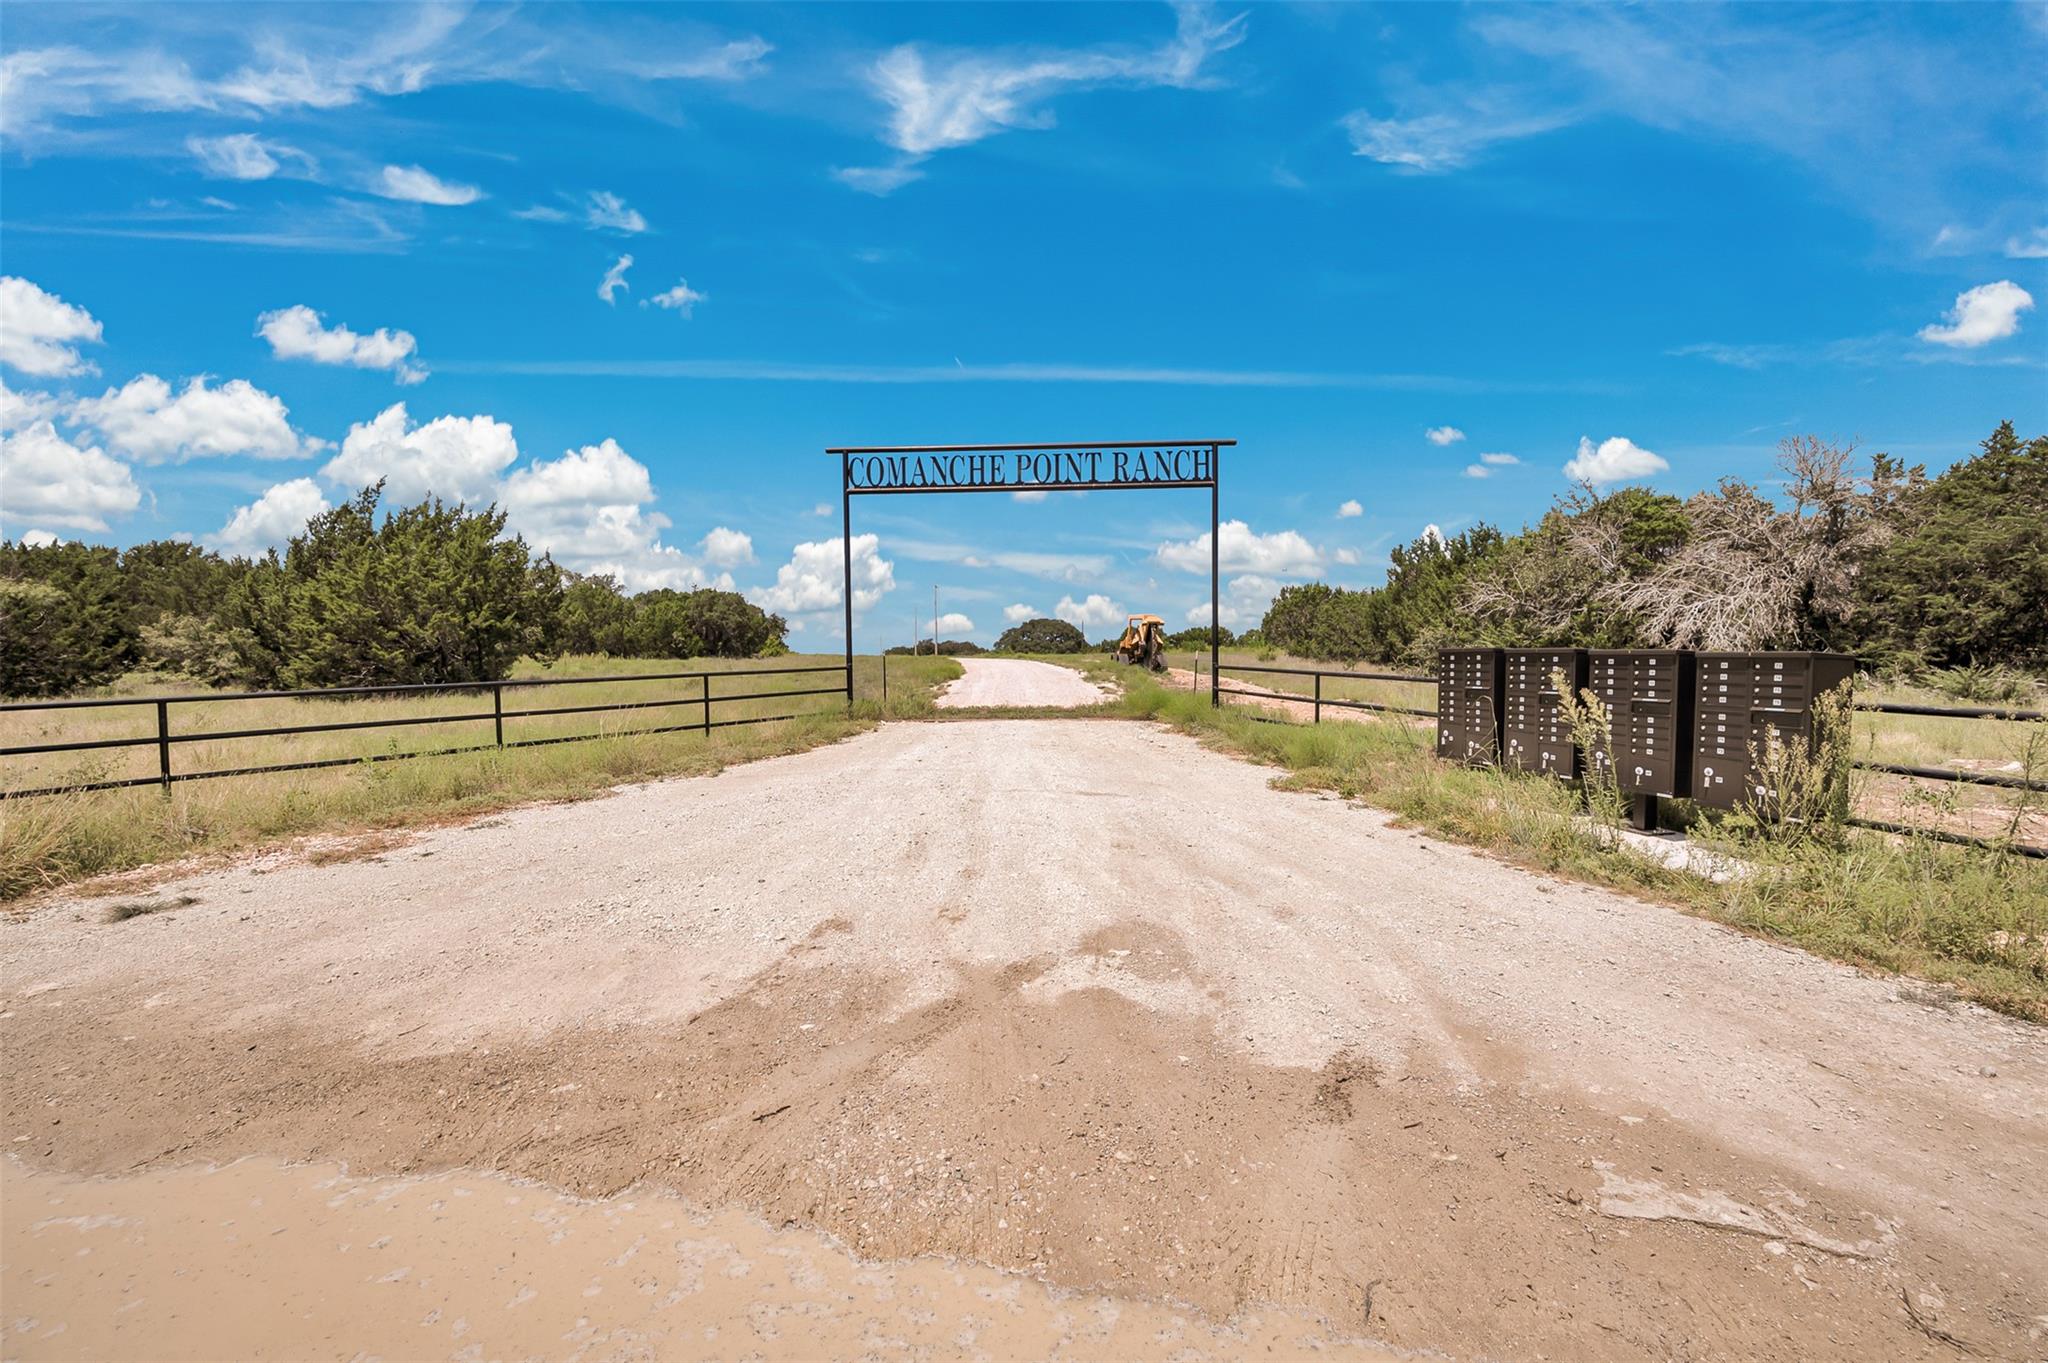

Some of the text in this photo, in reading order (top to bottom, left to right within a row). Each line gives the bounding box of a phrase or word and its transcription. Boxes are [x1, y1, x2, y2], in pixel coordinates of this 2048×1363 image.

[850, 450, 1212, 487] COMANCHE POINT RANCH
